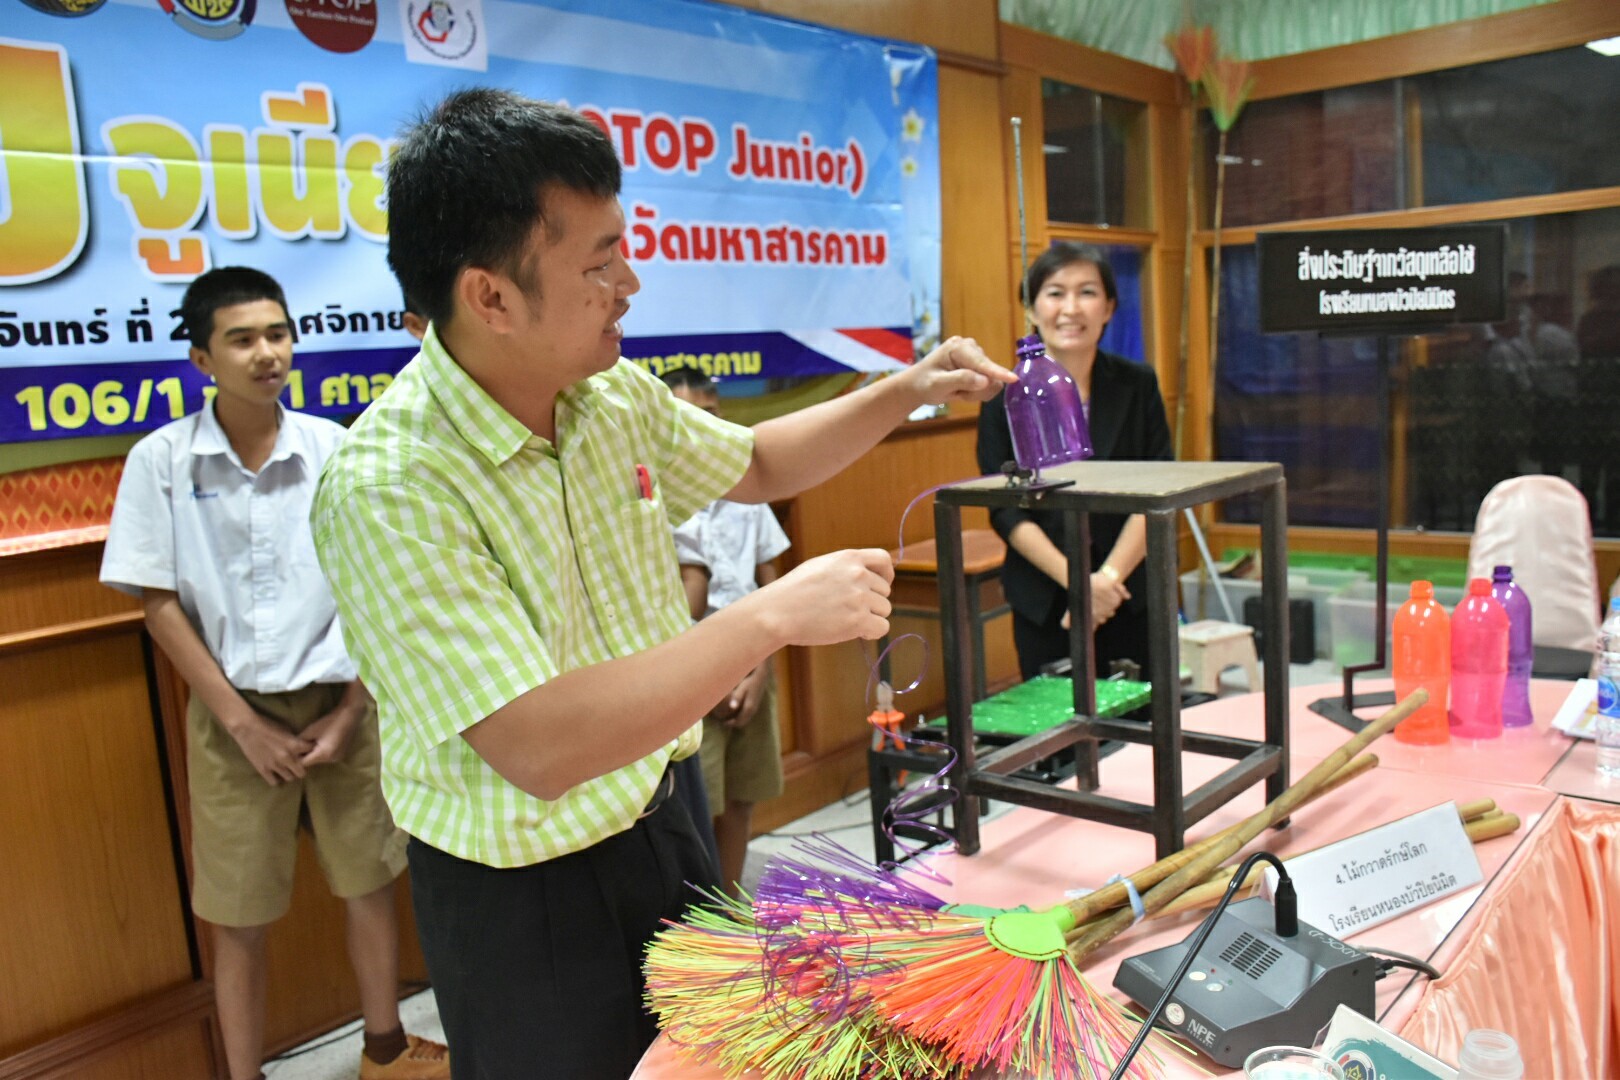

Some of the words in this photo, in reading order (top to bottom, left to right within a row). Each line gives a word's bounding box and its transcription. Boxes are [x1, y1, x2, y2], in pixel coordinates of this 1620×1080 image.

[104, 85, 399, 276] จูเนีย
[731, 128, 866, 194] Junior)
[620, 205, 887, 265] วัดมหาสารคาม
[126, 297, 153, 343] ที่
[169, 309, 191, 341] 2
[289, 304, 404, 344] ศจิกาย
[15, 377, 185, 431] 106/1
[321, 372, 397, 407] ศาล
[1187, 1018, 1217, 1045] NPE
